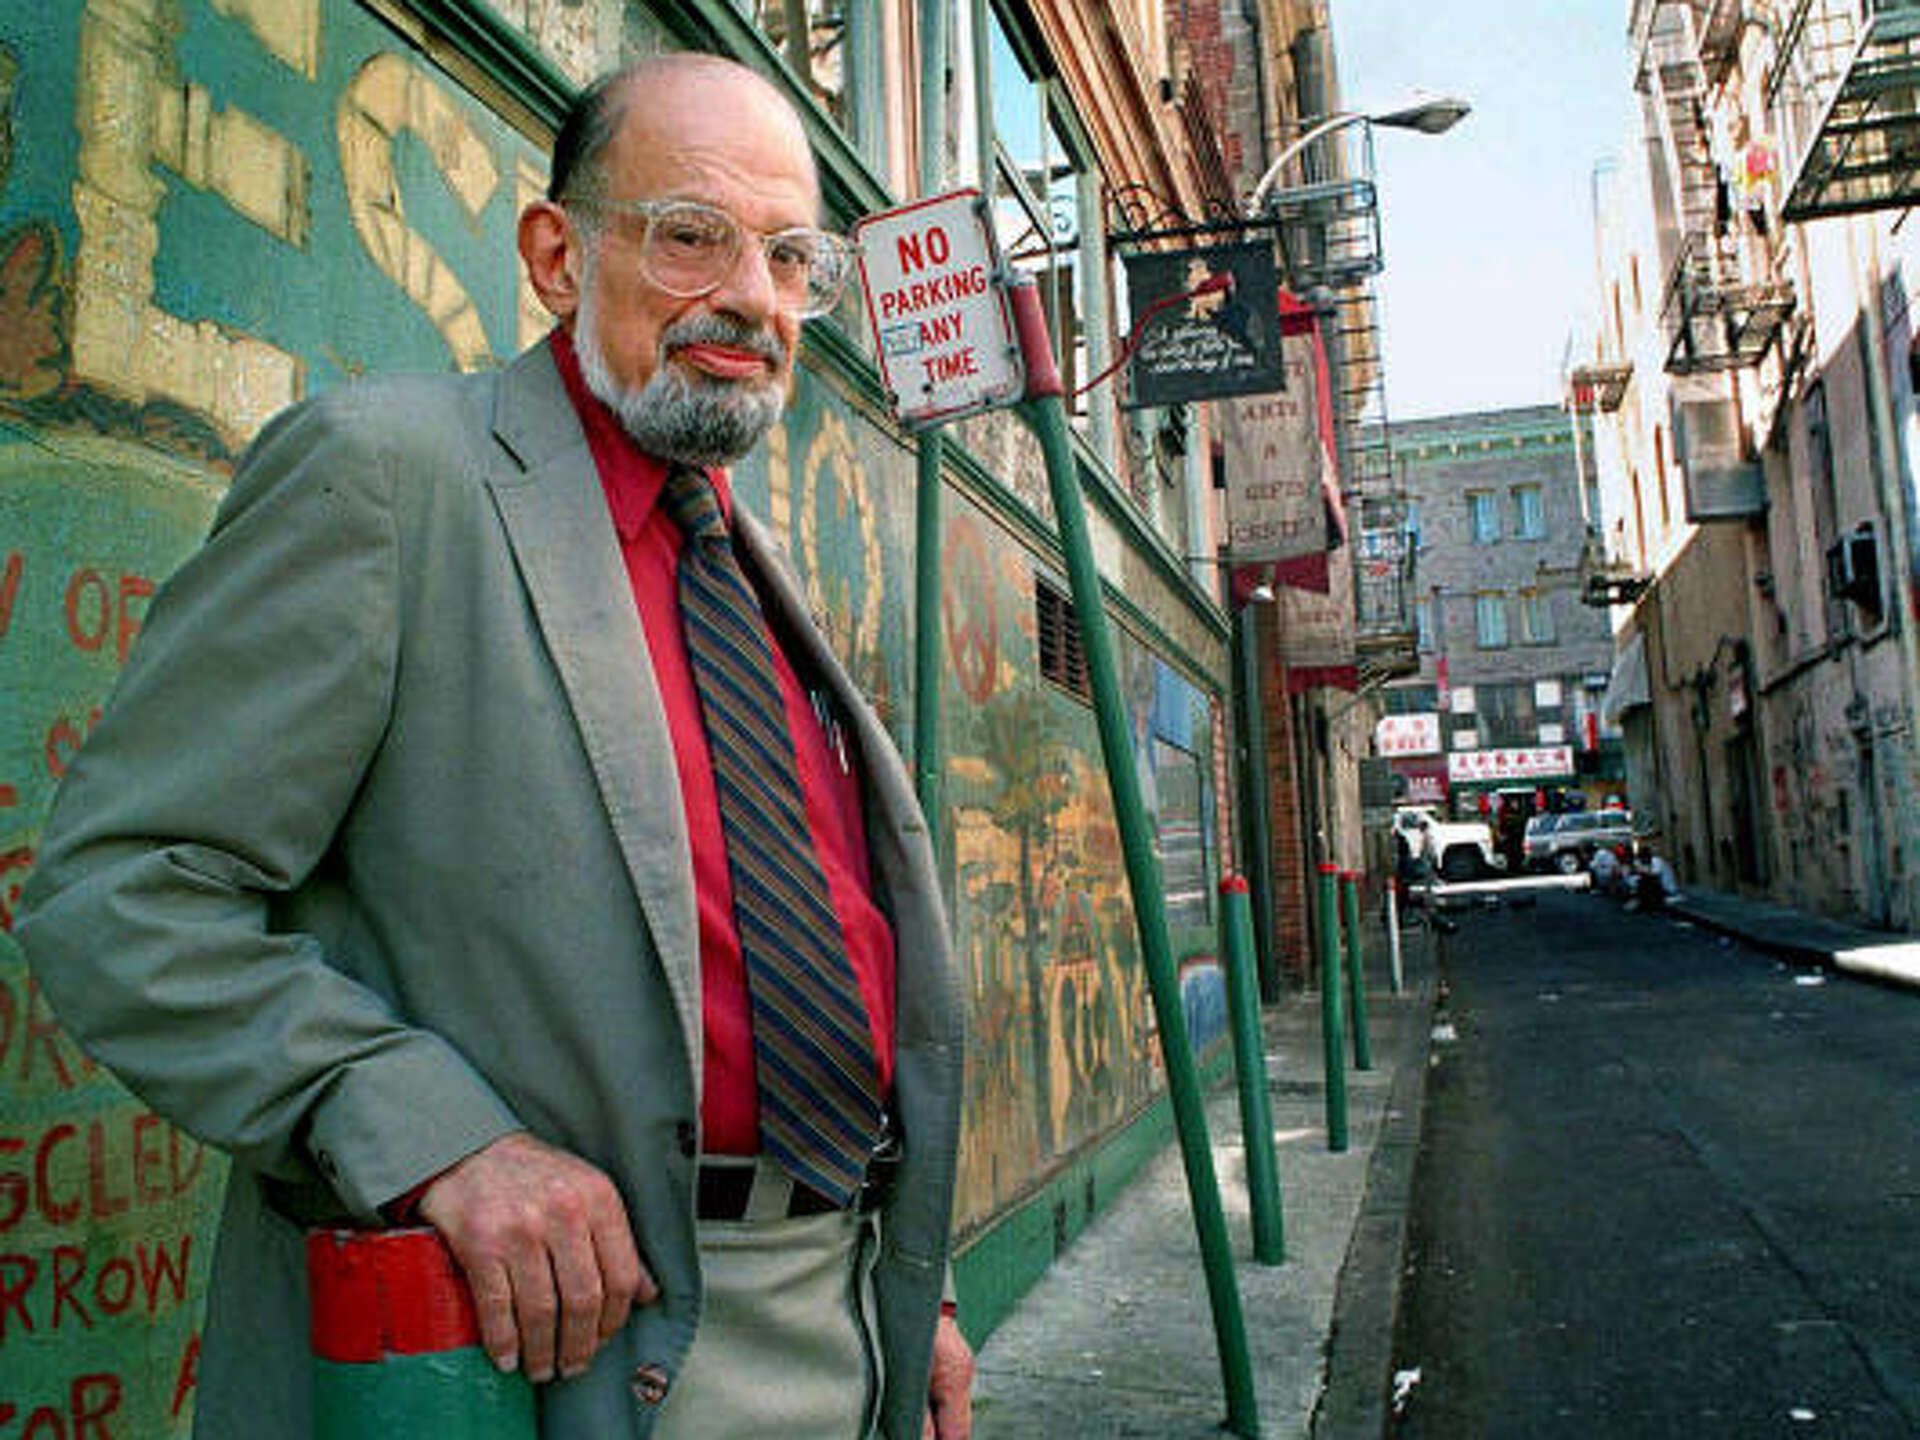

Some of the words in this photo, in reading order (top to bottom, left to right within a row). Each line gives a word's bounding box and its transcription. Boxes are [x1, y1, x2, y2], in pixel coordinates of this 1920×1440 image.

[897, 226, 950, 275] NO
[880, 265, 986, 318] PARKING
[919, 312, 962, 346] ANY
[923, 347, 979, 383] TIME
